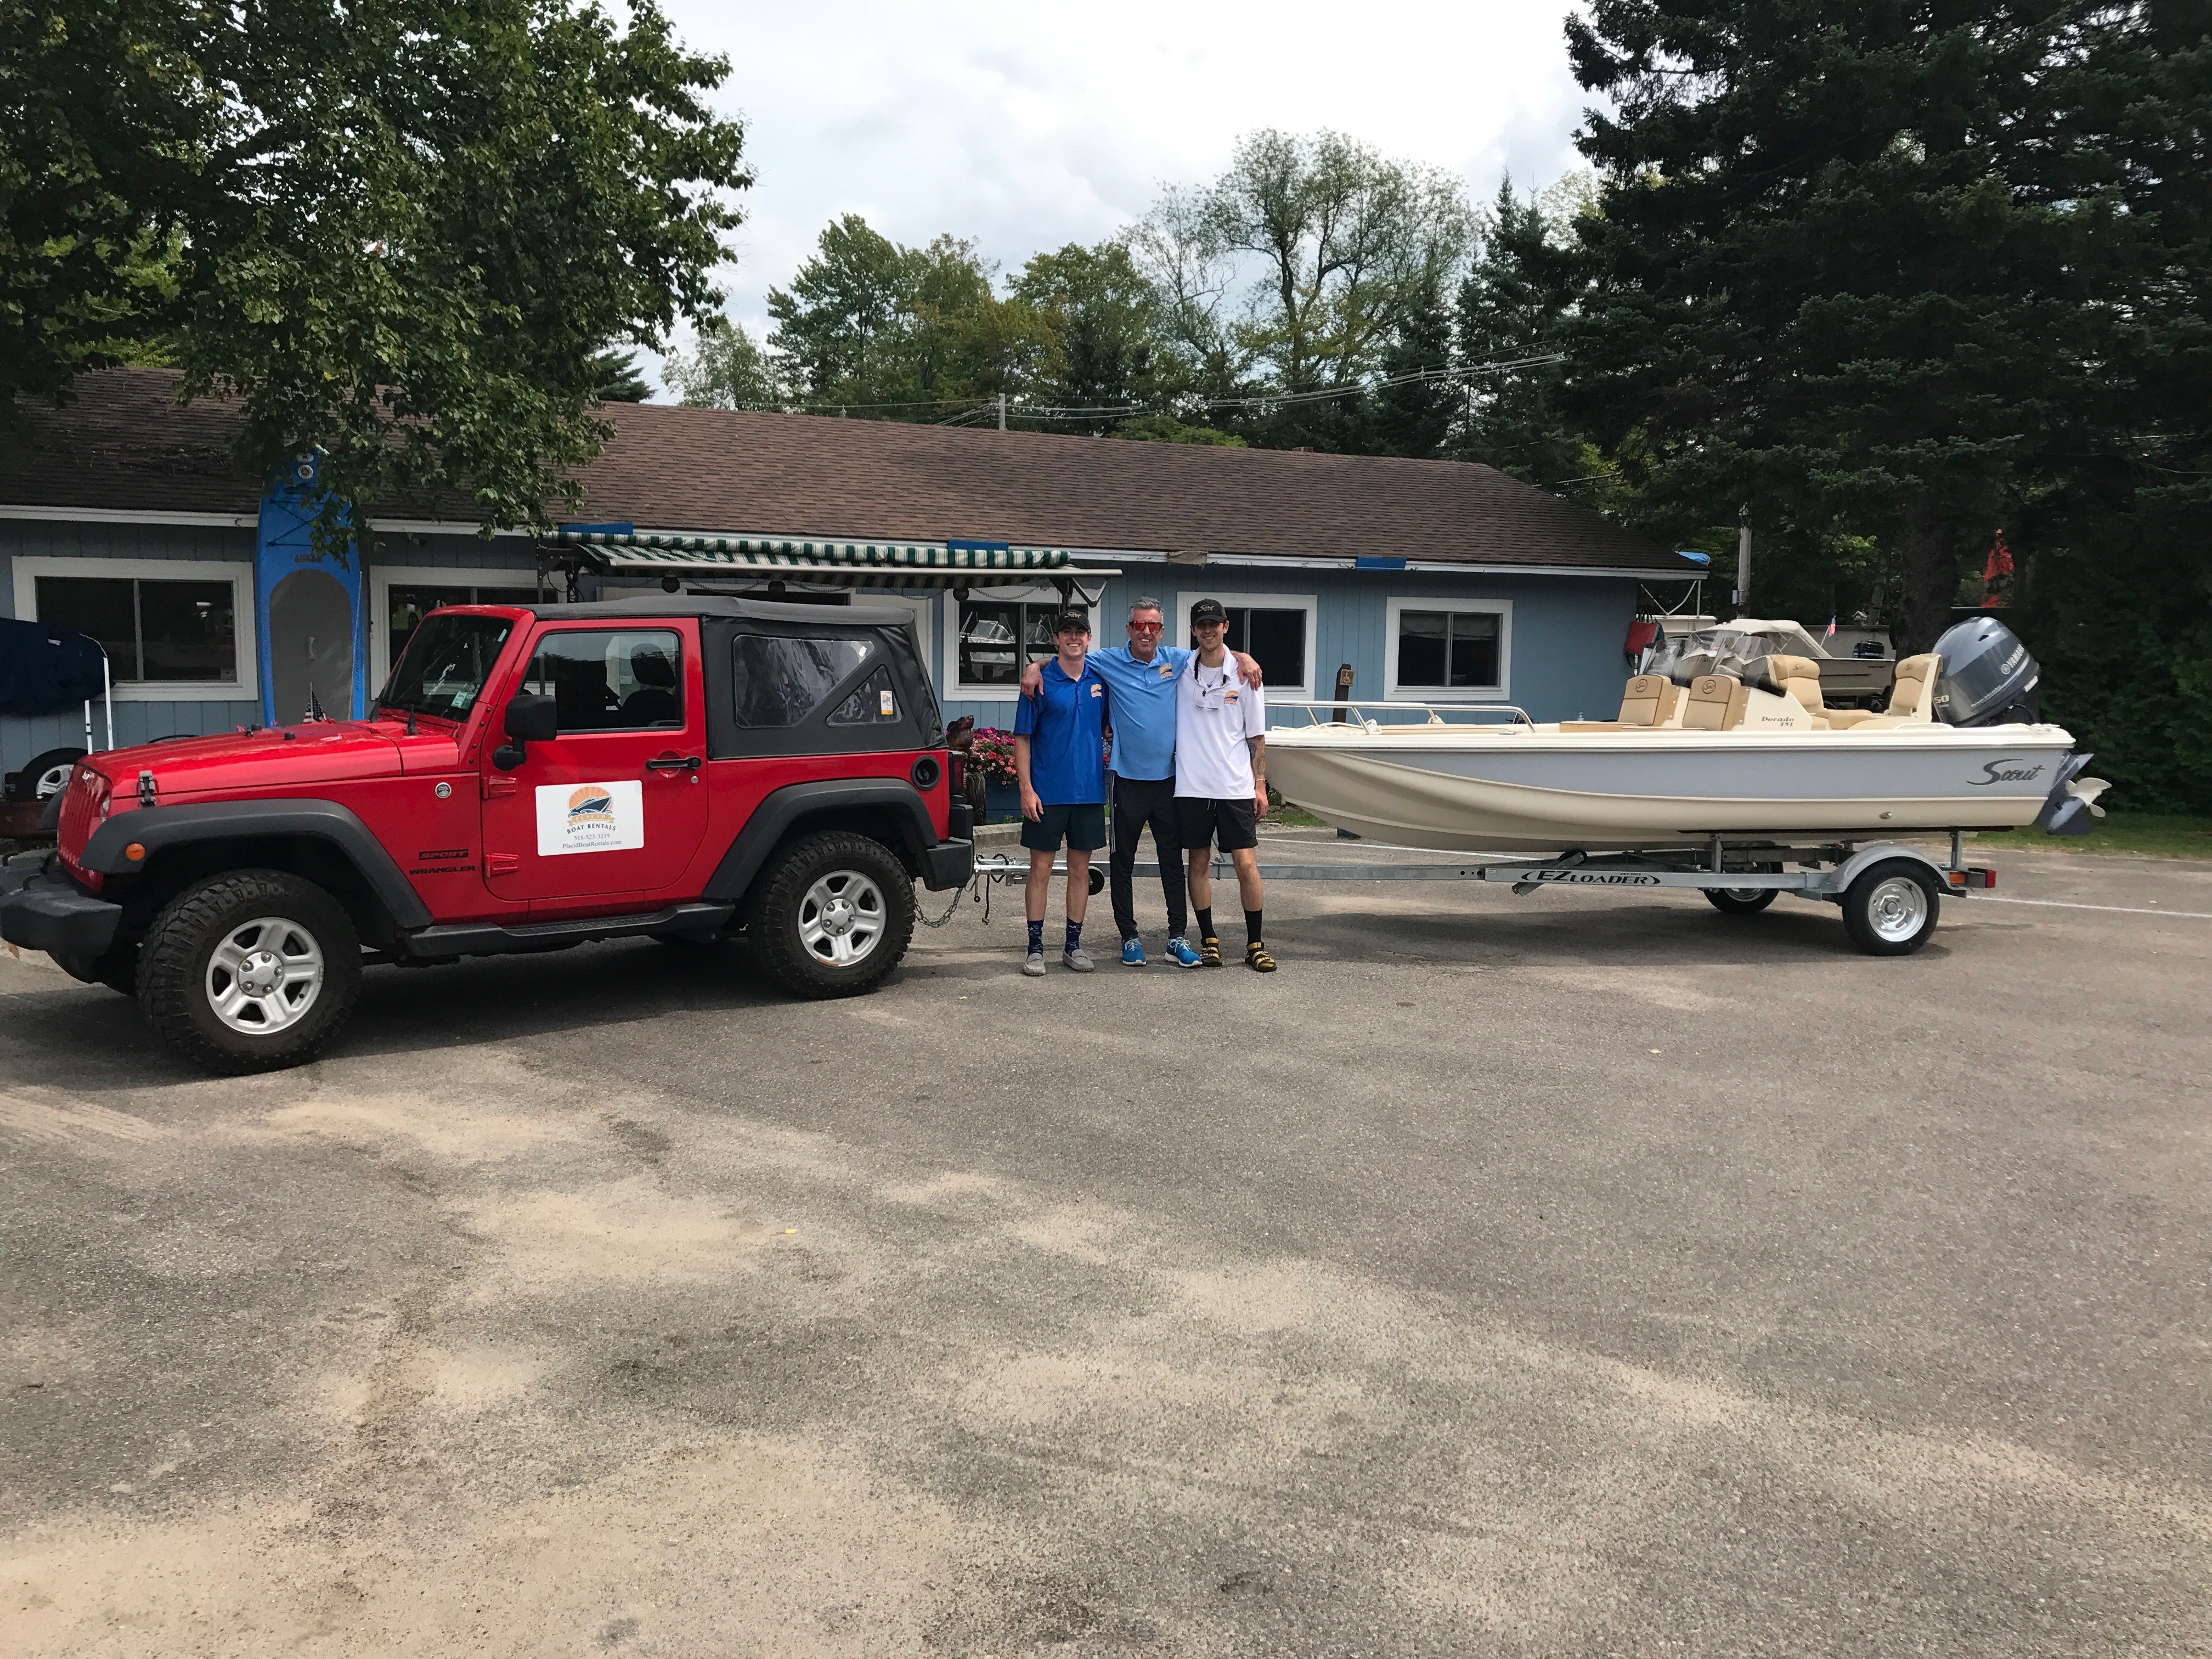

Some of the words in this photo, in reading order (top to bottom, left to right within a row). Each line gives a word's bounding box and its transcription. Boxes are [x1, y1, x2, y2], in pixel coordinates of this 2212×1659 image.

[1966, 758, 2046, 786] Scout
[567, 825, 584, 834] BOAT
[562, 840, 622, 849] PlacidBoatRentals.com
[409, 865, 476, 874] WRANGLER
